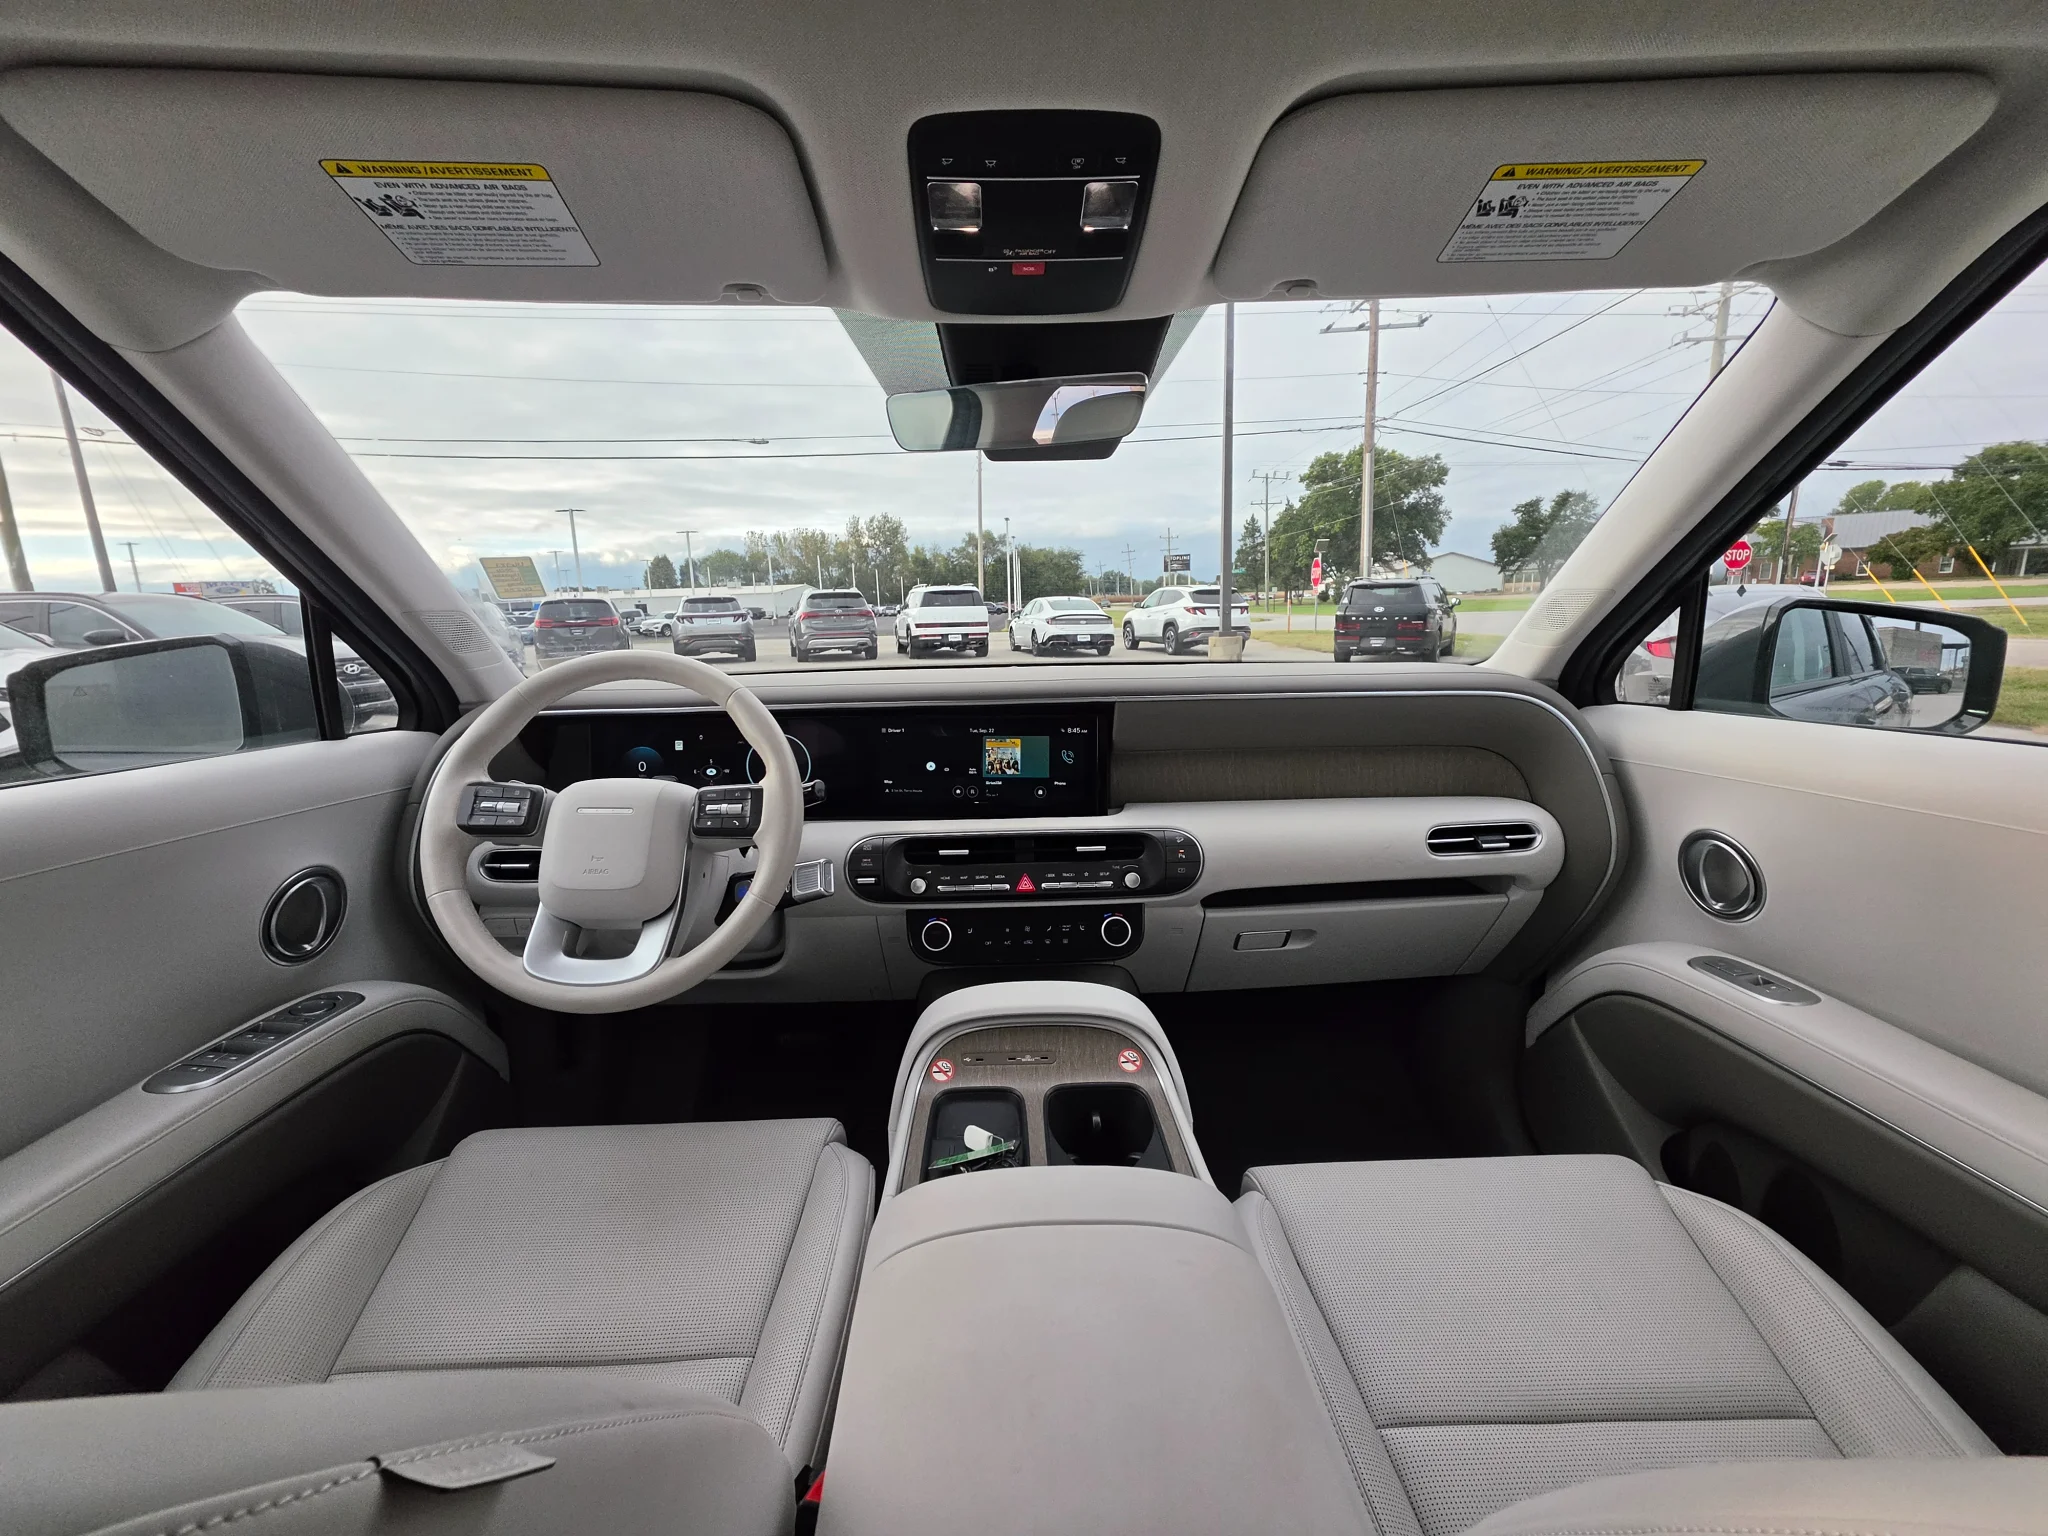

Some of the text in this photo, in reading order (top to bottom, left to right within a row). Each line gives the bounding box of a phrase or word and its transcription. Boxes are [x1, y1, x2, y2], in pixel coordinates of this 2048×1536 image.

[373, 181, 401, 189] EVEN
[1566, 181, 1614, 189] ADVANCED
[1725, 549, 1750, 562] STOP
[638, 761, 647, 772] 0
